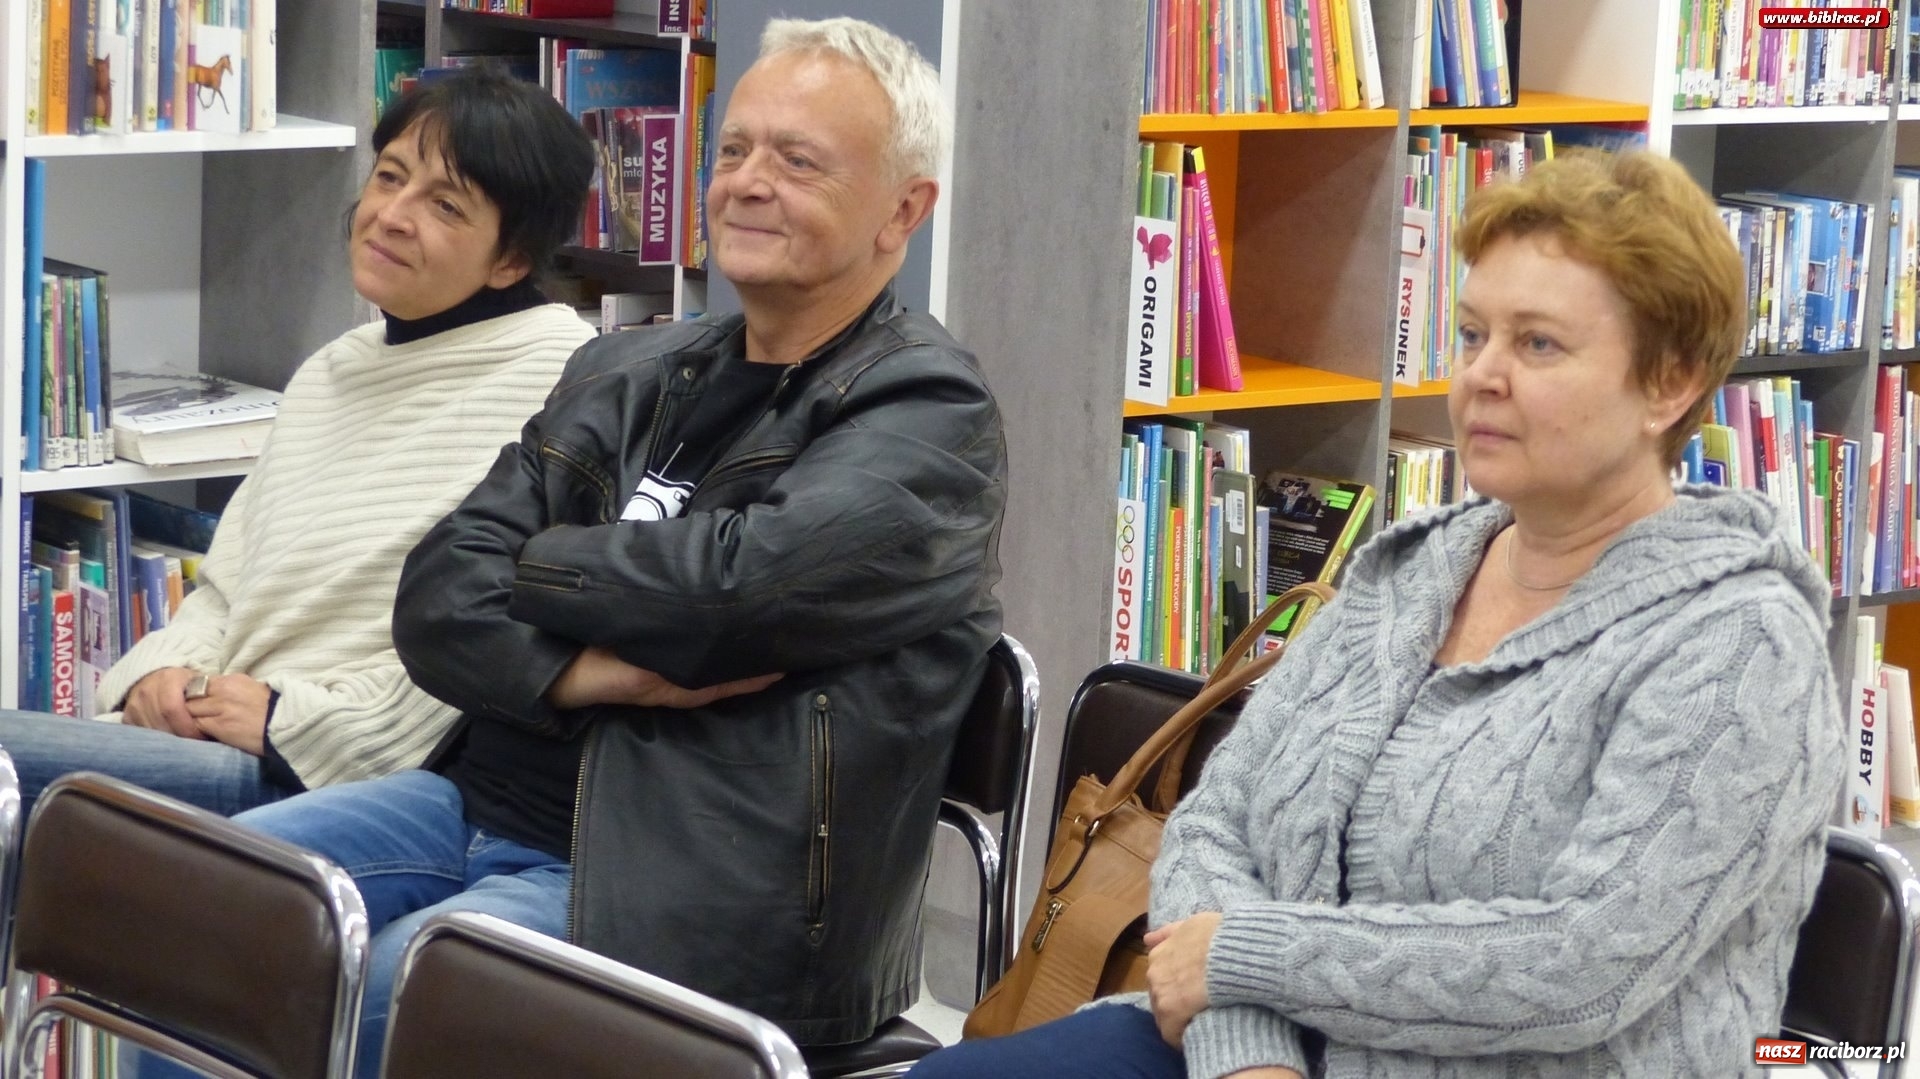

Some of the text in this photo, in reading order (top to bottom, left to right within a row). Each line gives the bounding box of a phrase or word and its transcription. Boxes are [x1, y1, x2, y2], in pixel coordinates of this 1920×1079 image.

[1323, 35, 1335, 85] TEKTURY
[649, 136, 667, 243] MUZYKA
[1138, 276, 1157, 388] ORIGAMI
[1184, 311, 1192, 356] ORIGAMI
[1395, 277, 1413, 379] RYSUNEK
[1890, 382, 1900, 445] RODZINNA
[23, 520, 31, 554] BUDOWLE
[1886, 486, 1896, 542] ZAGADEK
[21, 569, 29, 612] TRANSPORT
[55, 611, 73, 717] SAMOCH
[1859, 687, 1875, 787] HOBBY
